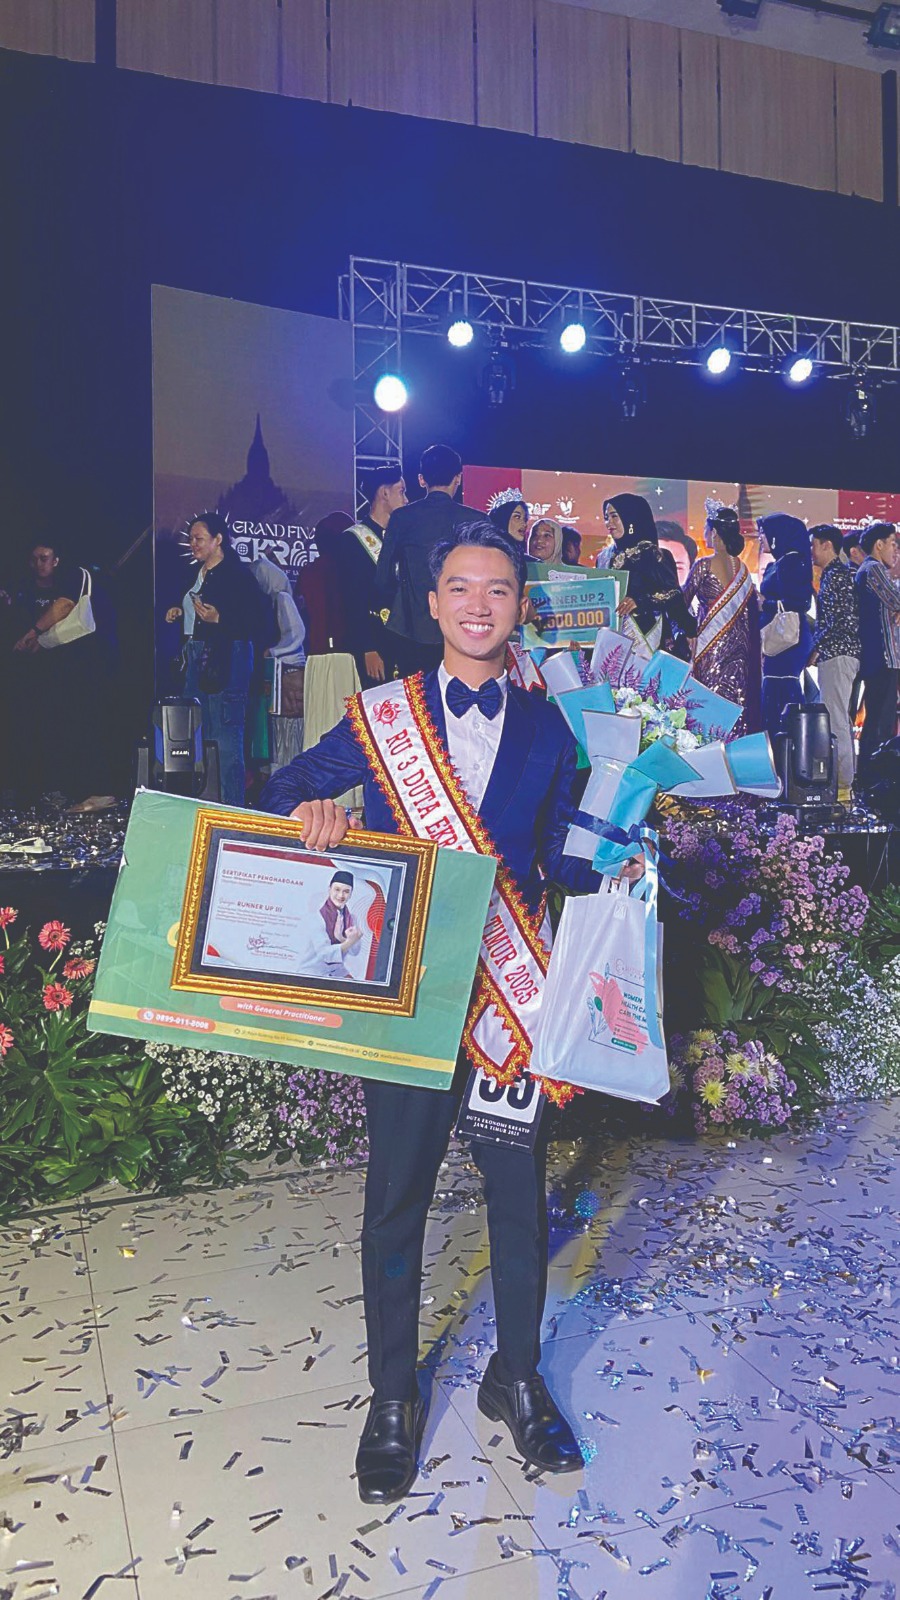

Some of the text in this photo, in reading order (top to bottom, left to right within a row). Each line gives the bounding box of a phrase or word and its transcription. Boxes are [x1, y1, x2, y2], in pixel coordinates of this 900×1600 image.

[232, 520, 285, 537] GRAND
[580, 593, 596, 603] UP
[598, 592, 605, 601] 2
[385, 728, 464, 851] RU 3 DUTA EKR
[222, 868, 256, 880] SERTIFIKAT
[237, 901, 263, 910] RUNNER
[482, 914, 539, 1005] TIMUR 2025
[623, 992, 642, 1003] WOMEN
[236, 1002, 326, 1023] with General Practitioner
[466, 1114, 530, 1134] DUTA EKONOMI KREATIF
[473, 1121, 488, 1130] JAWA
[489, 1125, 507, 1134] TIMUR
